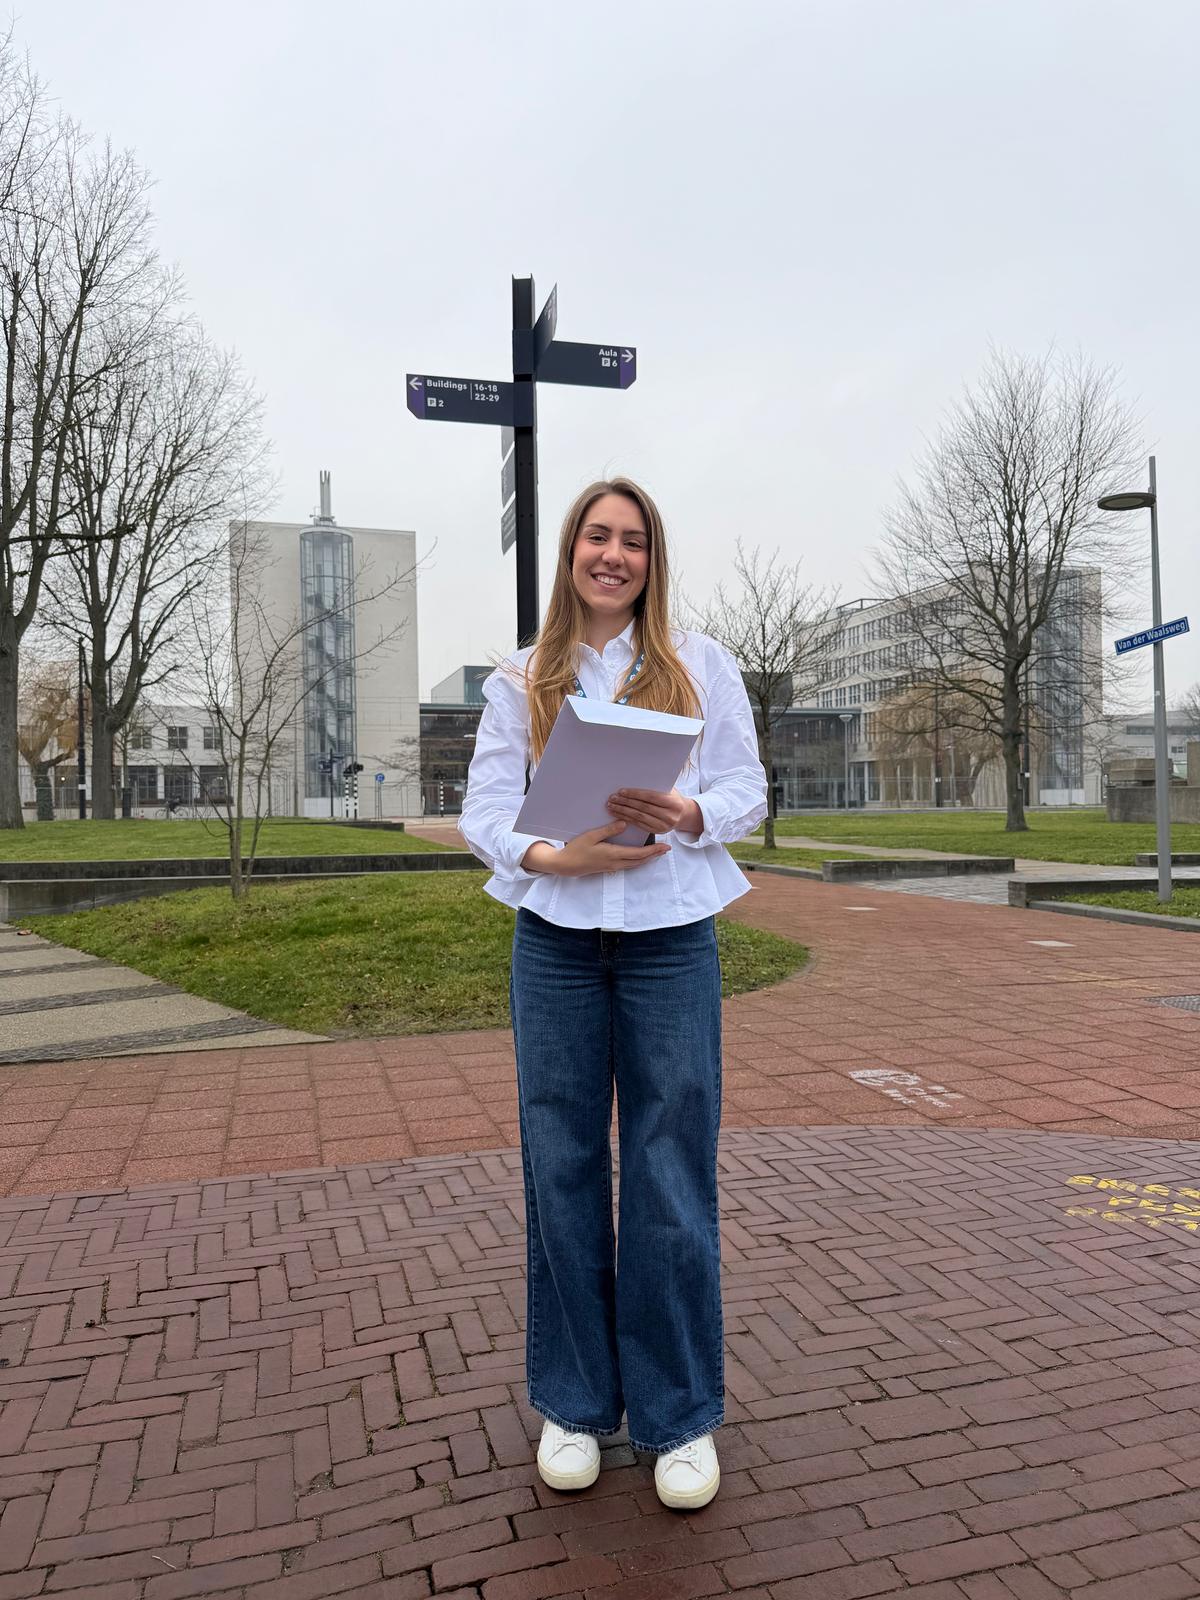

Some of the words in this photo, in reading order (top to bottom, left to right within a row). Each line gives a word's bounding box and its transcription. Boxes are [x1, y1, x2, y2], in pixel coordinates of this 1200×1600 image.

[599, 348, 618, 357] Aula
[426, 379, 467, 392] Buildings
[474, 383, 498, 392] 16-18
[474, 393, 500, 402] 22-29
[1118, 641, 1132, 650] Van
[1133, 635, 1146, 645] der
[1147, 621, 1186, 640] Waalsweg
